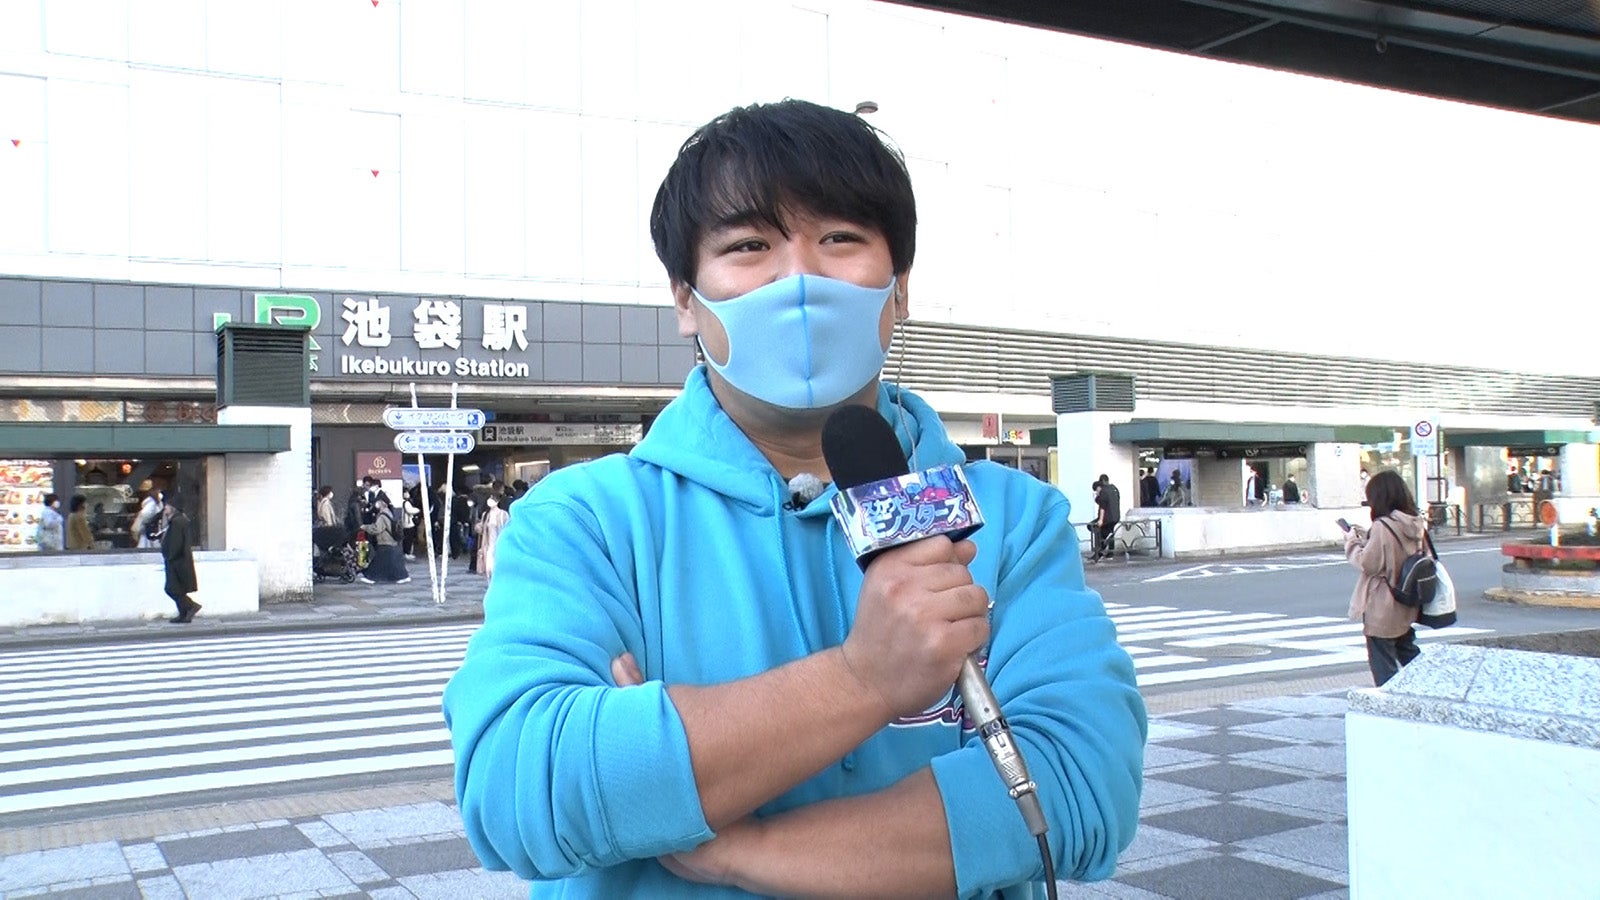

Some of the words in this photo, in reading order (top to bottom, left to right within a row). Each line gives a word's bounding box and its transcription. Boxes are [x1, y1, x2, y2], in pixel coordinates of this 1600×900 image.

[341, 297, 529, 351] 池袋駅
[341, 354, 450, 376] Ikebukuro
[455, 357, 529, 377] Station
